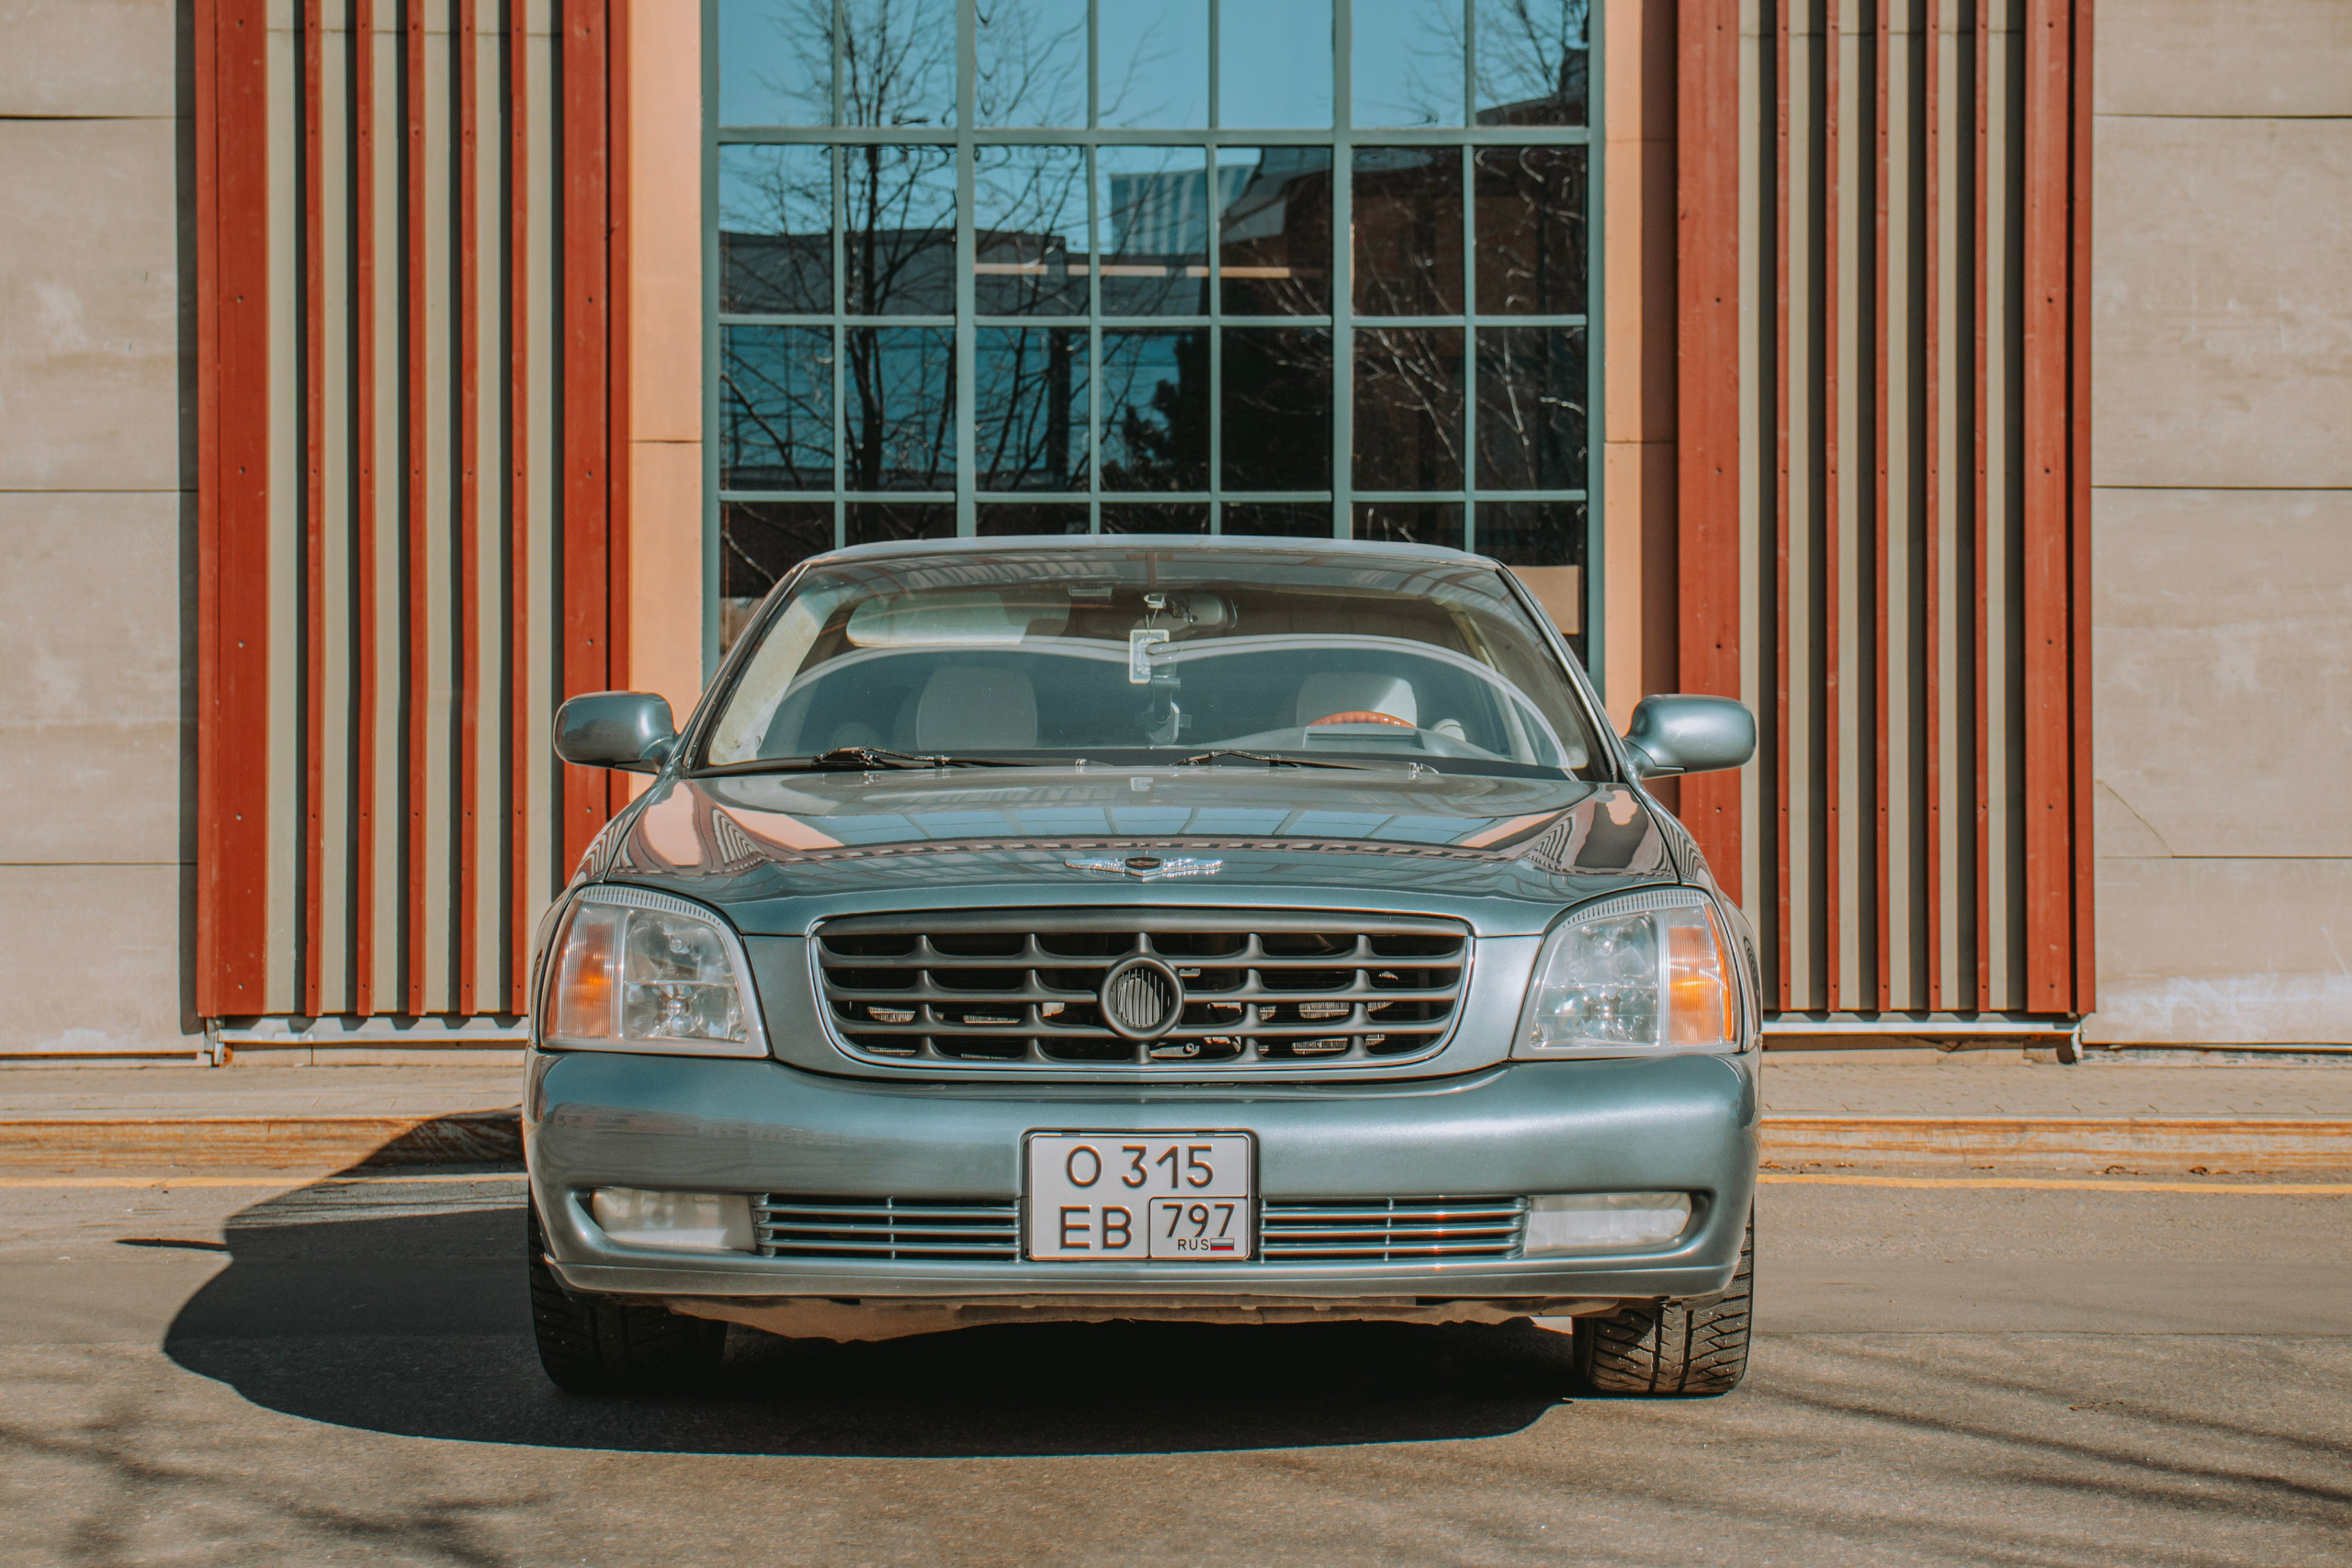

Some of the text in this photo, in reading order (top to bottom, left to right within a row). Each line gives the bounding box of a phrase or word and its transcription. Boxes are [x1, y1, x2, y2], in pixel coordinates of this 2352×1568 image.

[1066, 1145, 1214, 1189] O 315
[1059, 1205, 1132, 1249] EB
[1162, 1203, 1235, 1237] 797
[1178, 1239, 1209, 1250] RUS
